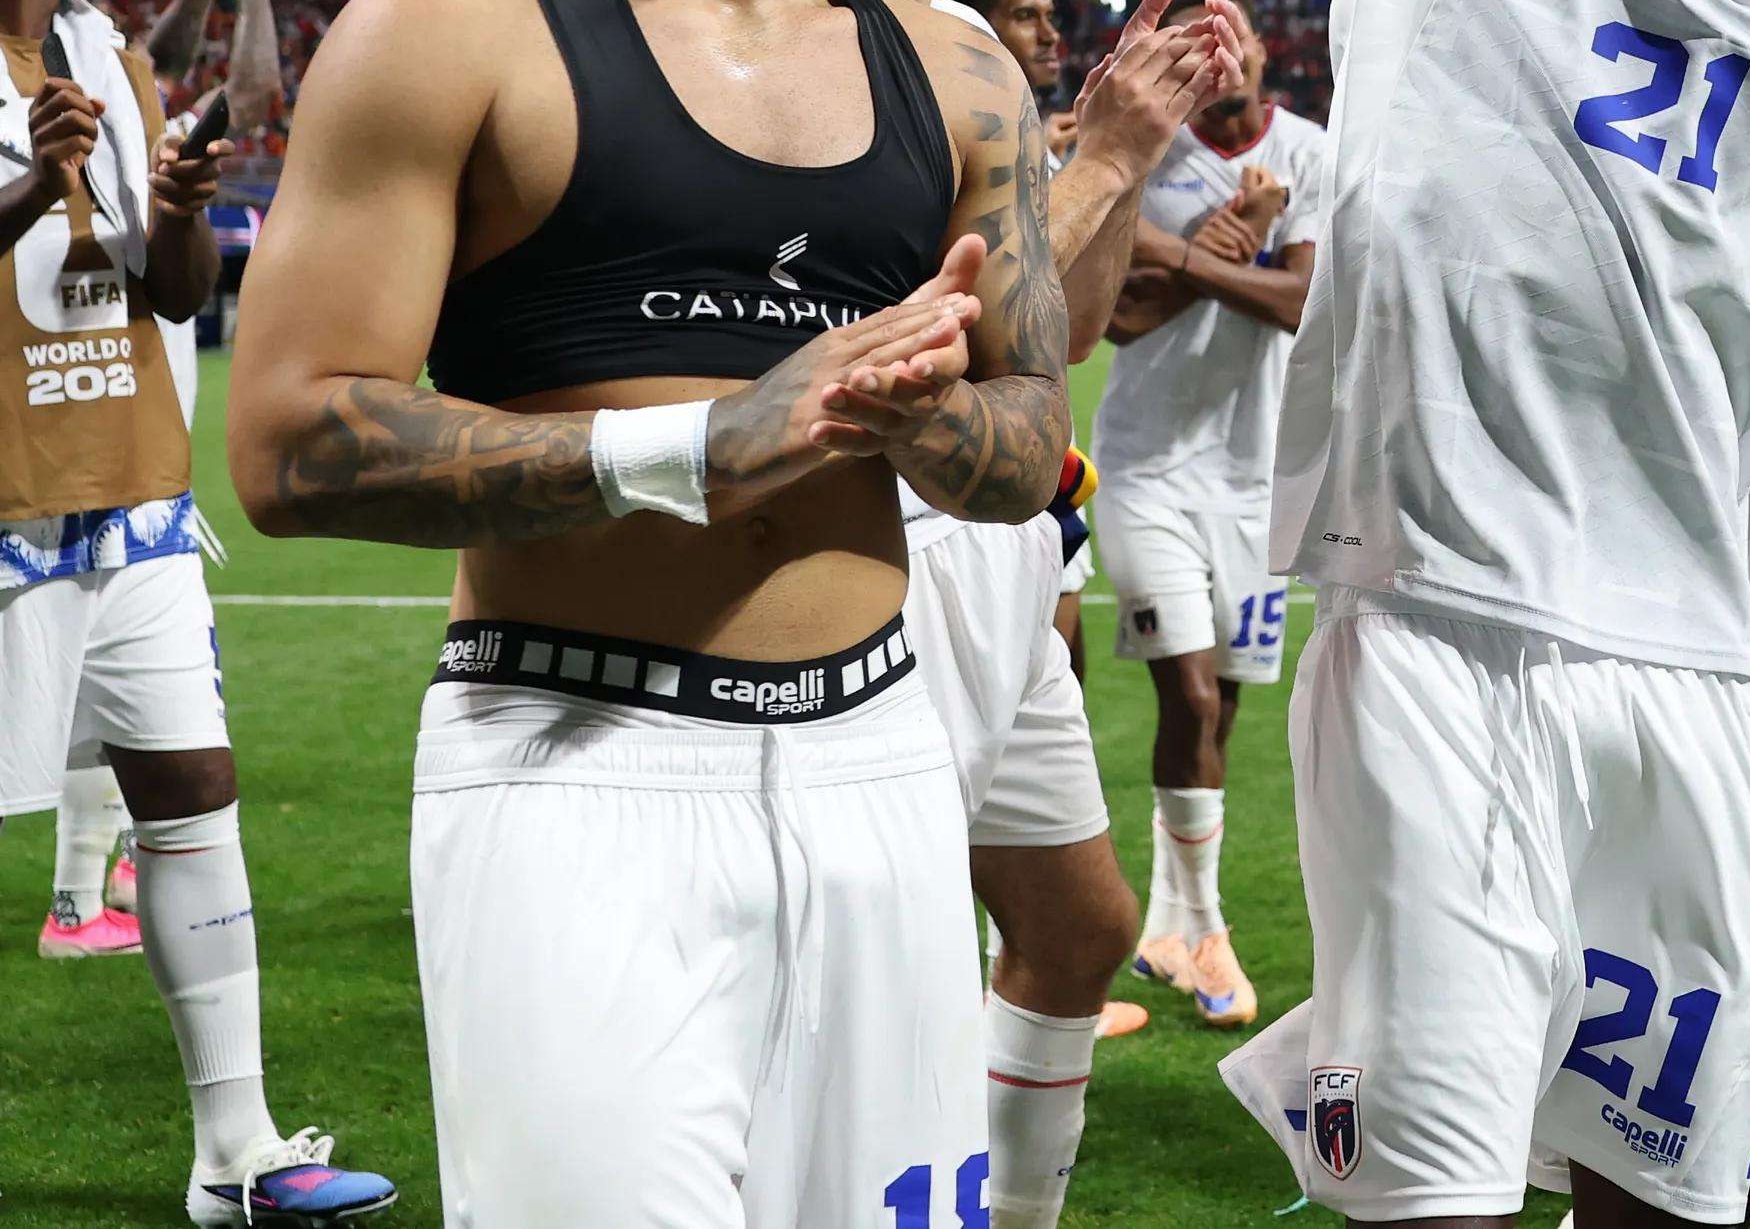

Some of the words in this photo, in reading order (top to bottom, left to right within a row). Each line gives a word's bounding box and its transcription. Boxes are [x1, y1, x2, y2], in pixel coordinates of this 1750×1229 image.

[61, 281, 122, 308] FIFA
[23, 337, 118, 367] WORLD
[1229, 590, 1286, 648] 15
[438, 630, 503, 670] apelli
[450, 660, 497, 673] SPORT
[710, 668, 825, 712] capelli
[766, 698, 825, 716] SPORT
[1560, 947, 1722, 1129] 21
[1314, 1073, 1356, 1091] FCF
[1600, 1103, 1689, 1161] capelli
[1630, 1142, 1680, 1169] SPORT
